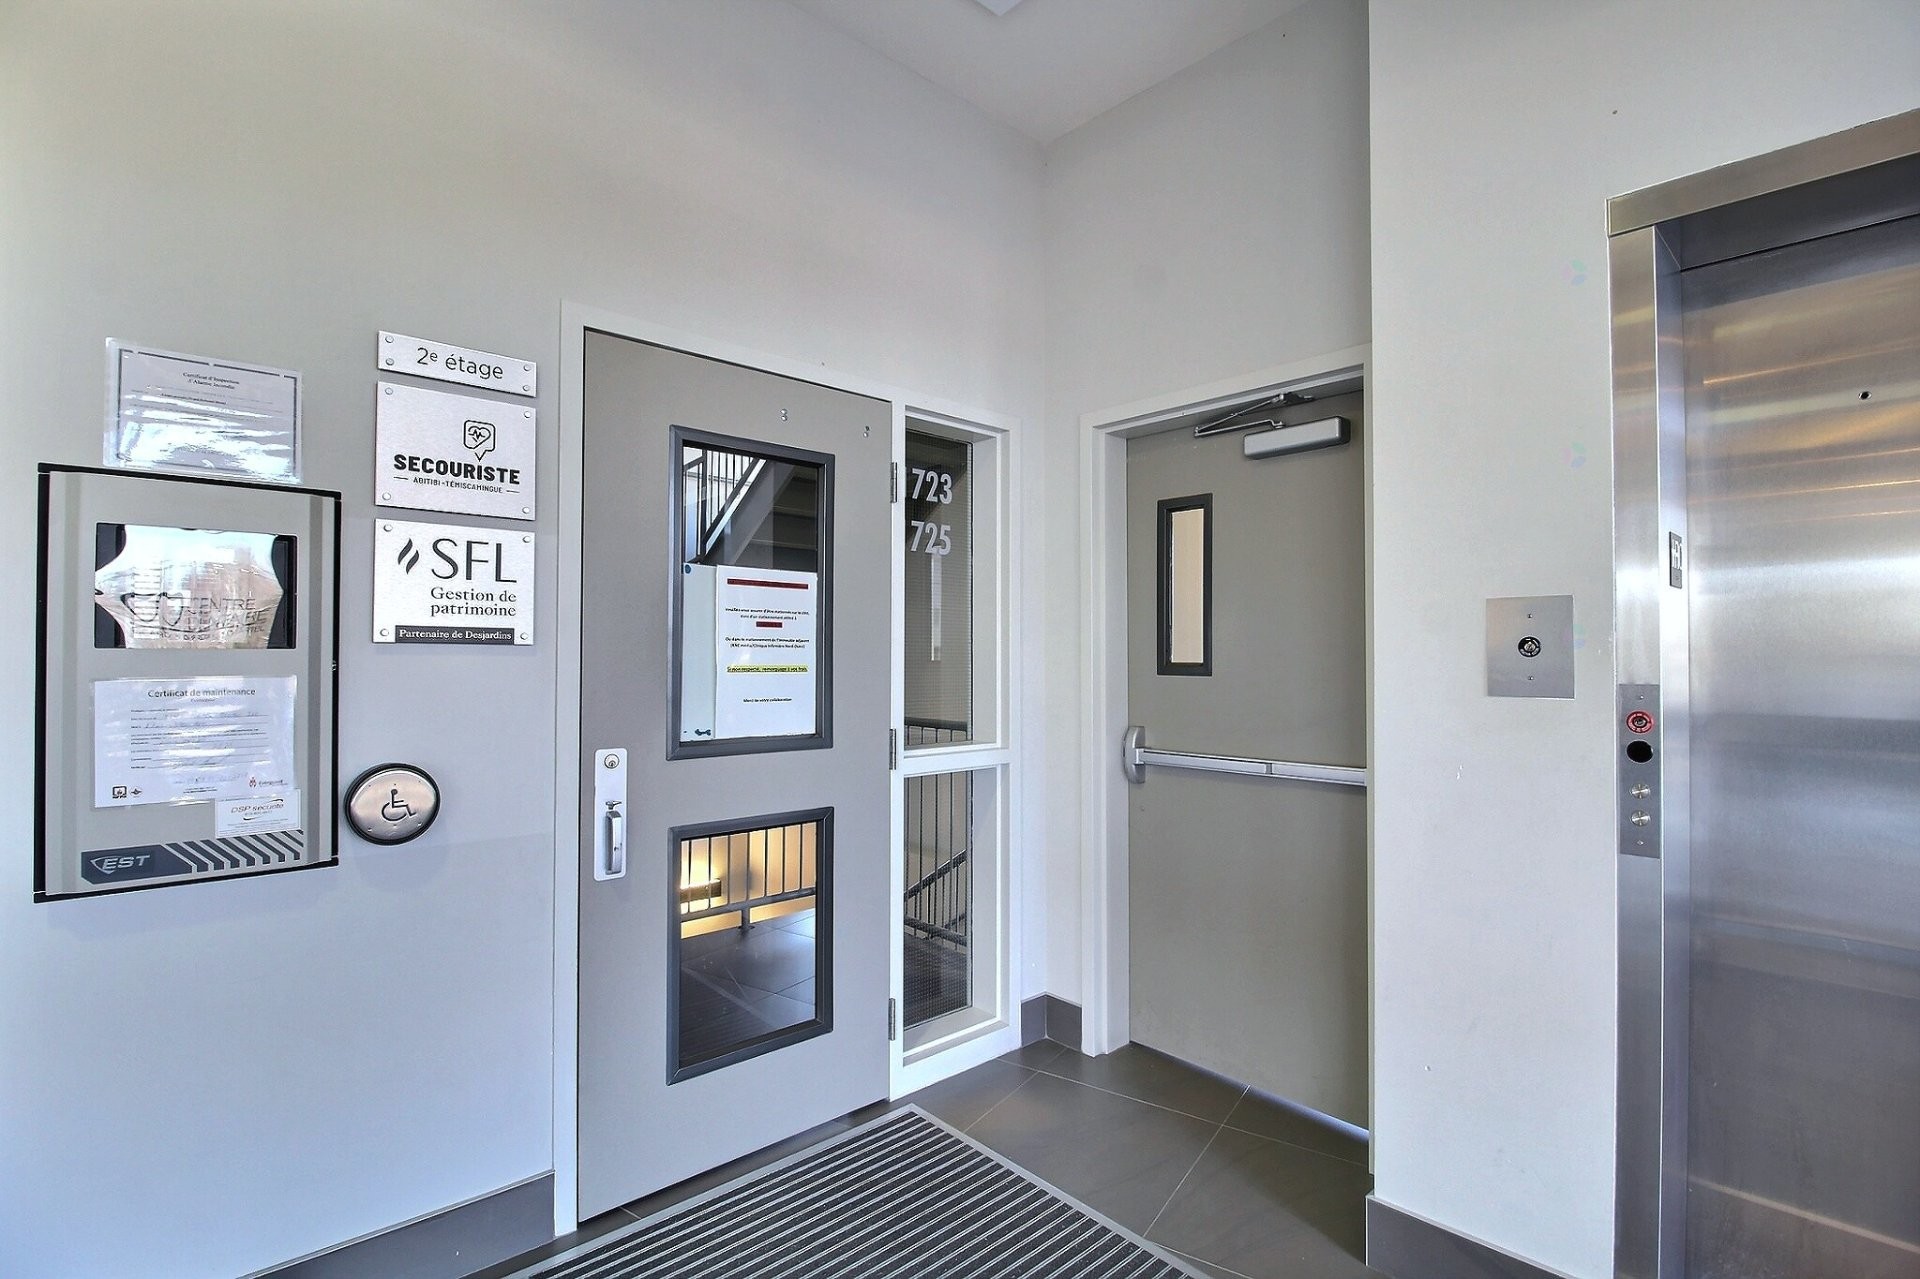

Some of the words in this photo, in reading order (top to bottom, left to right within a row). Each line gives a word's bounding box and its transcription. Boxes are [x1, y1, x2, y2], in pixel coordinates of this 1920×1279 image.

[445, 354, 504, 380] étage
[393, 454, 521, 485] SECOURISTE
[911, 467, 953, 505] 723
[910, 520, 952, 556] 725
[431, 537, 517, 583] SFL
[430, 586, 494, 602] Gestion
[499, 589, 517, 603] de
[430, 601, 517, 617] patrimoine
[399, 629, 450, 639] Partenaire
[451, 630, 463, 639] de
[465, 630, 512, 641] Desjardins
[147, 689, 188, 698] Certificat
[189, 688, 201, 697] de
[202, 688, 256, 697] maintenance
[102, 854, 150, 869] EST
